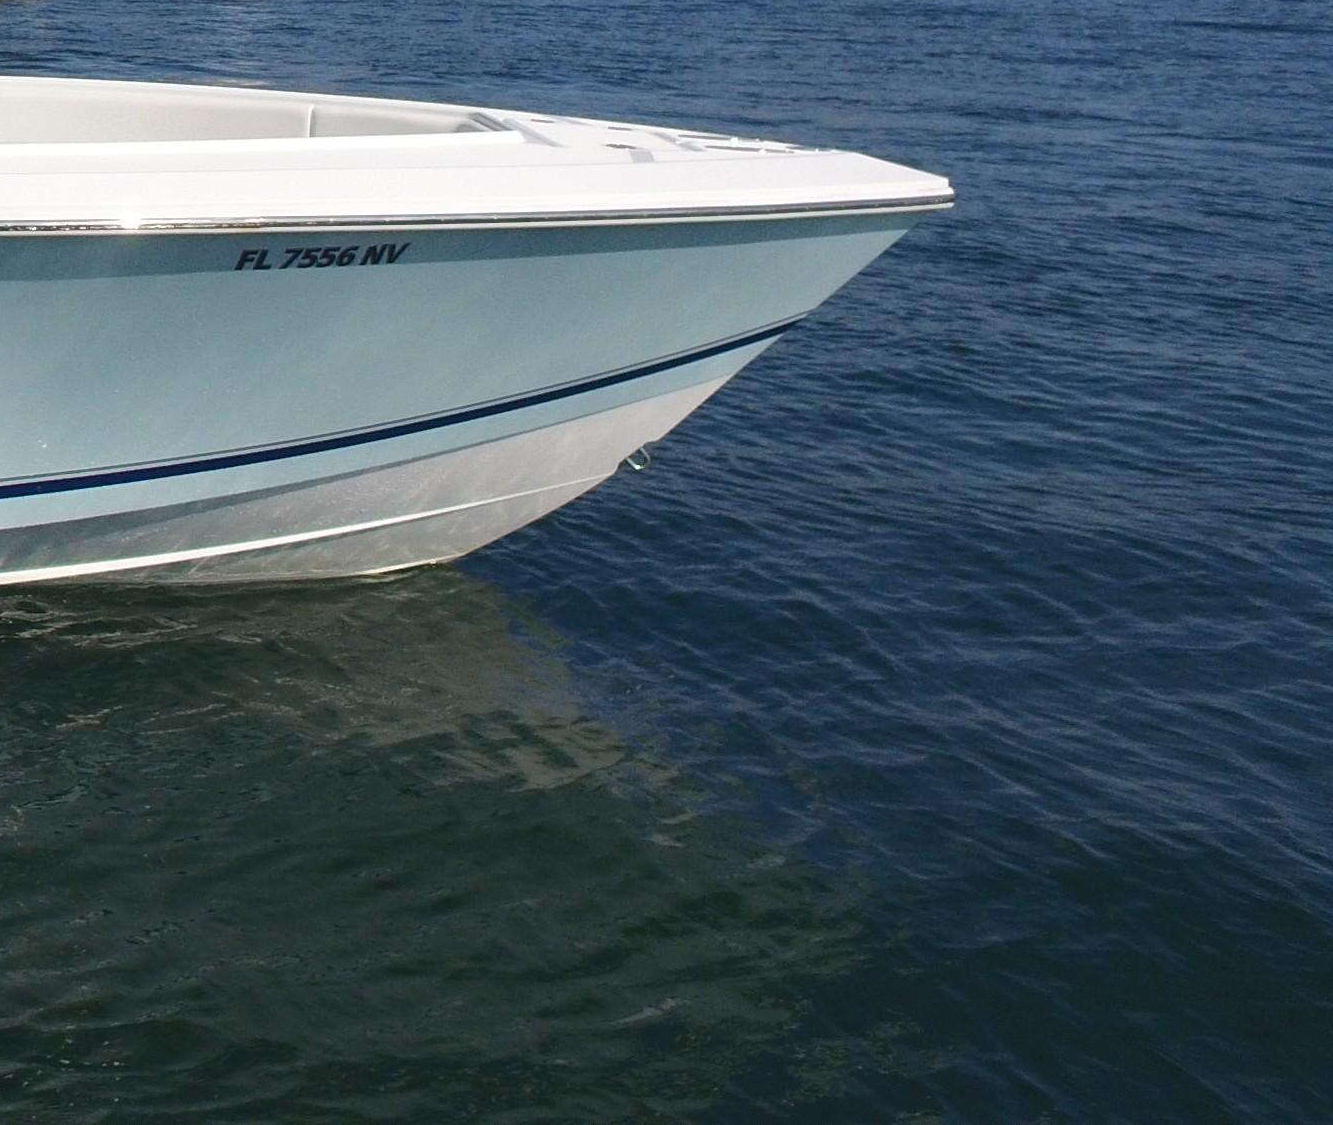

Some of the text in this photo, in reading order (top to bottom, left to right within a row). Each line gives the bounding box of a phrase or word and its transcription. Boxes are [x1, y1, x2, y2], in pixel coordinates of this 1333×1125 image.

[234, 242, 411, 271] FL 7556 NV
